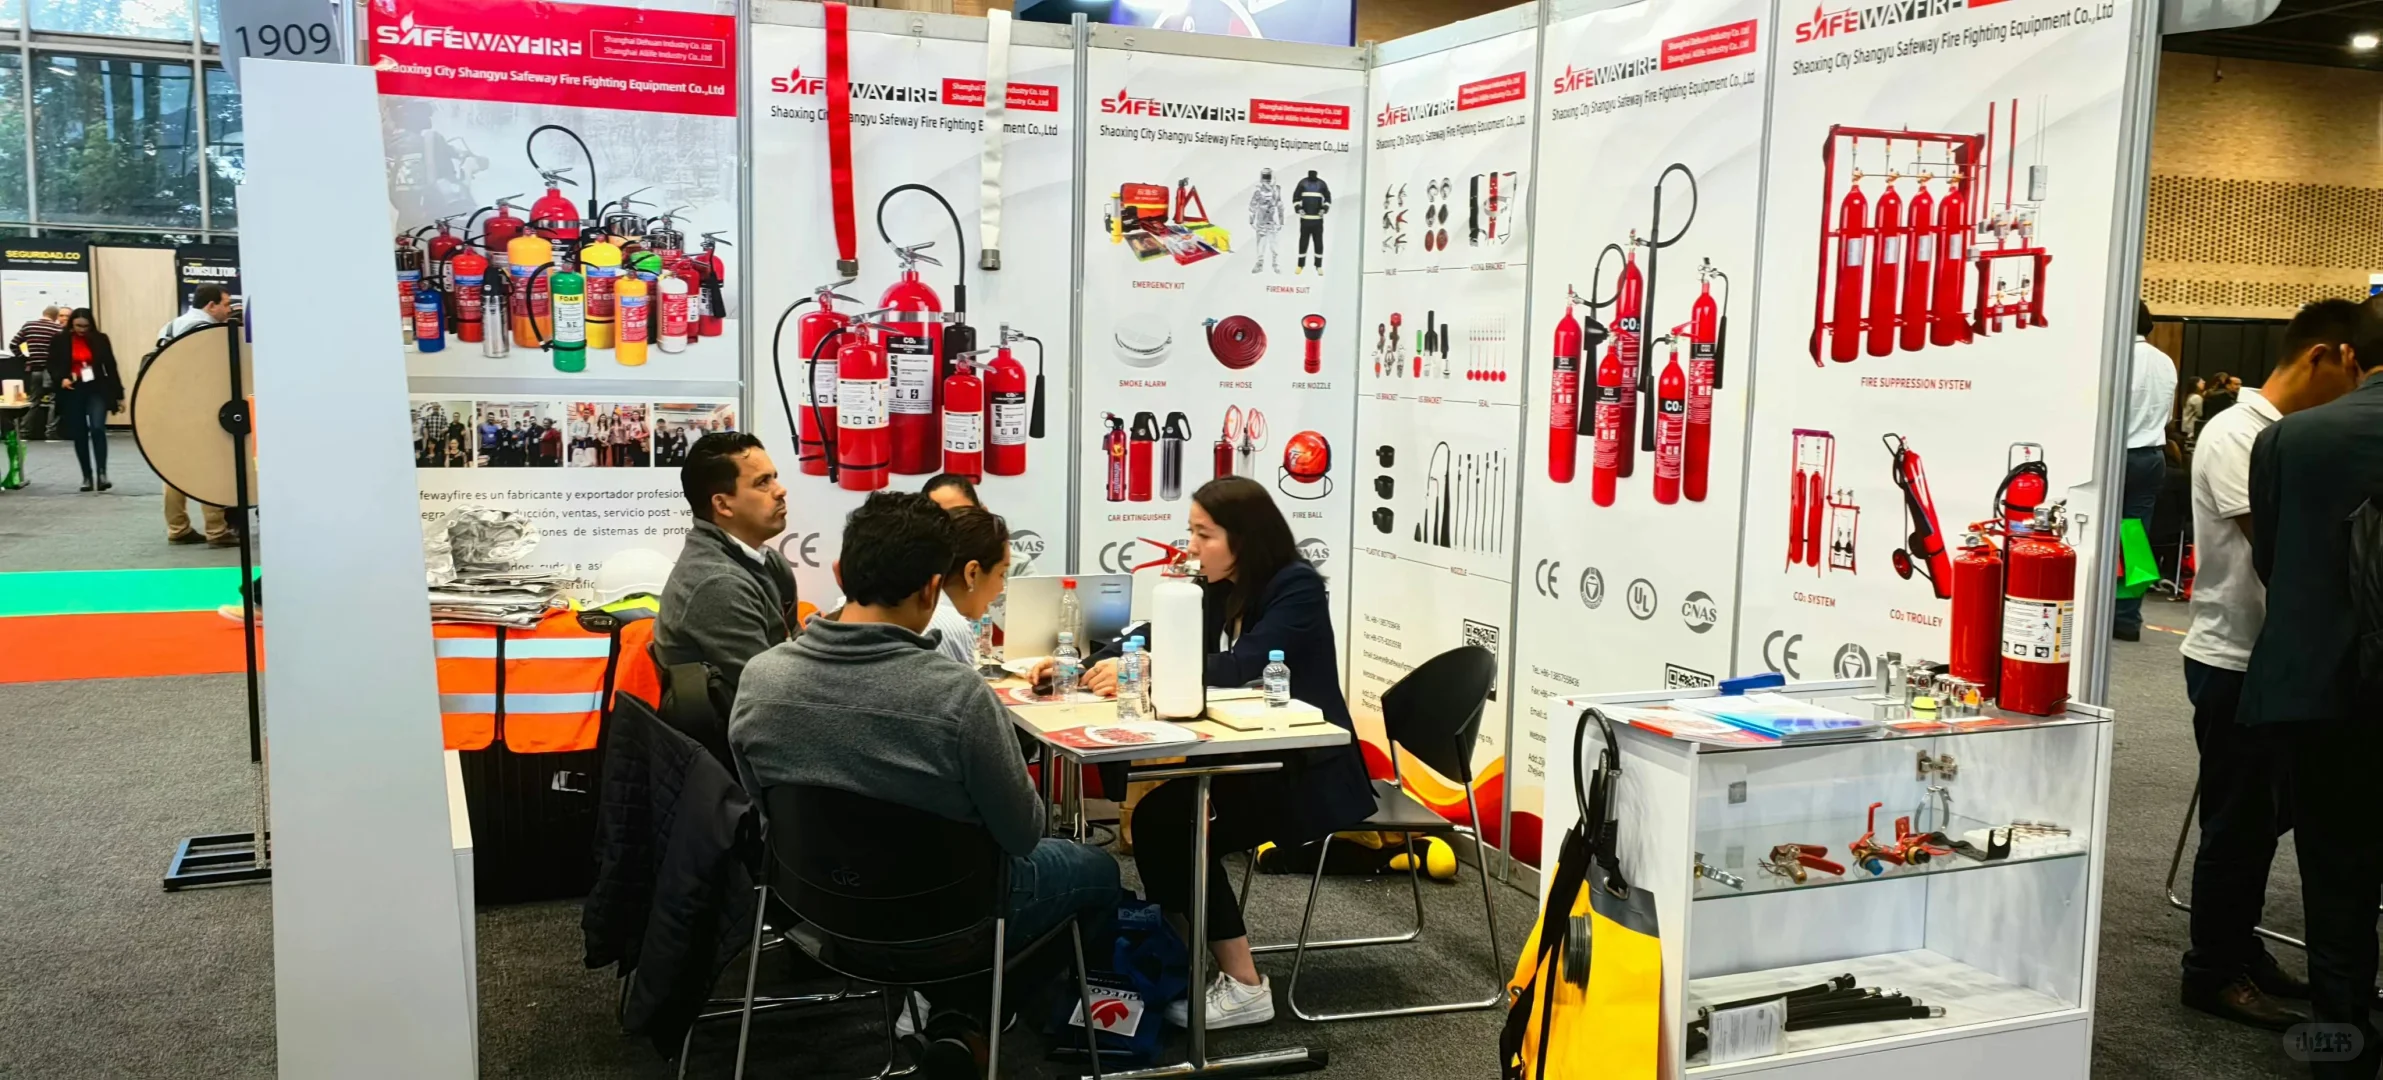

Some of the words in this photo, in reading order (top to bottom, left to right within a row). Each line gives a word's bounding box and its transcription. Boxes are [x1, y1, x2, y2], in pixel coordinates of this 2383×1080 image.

[235, 23, 331, 57] 1909
[377, 24, 582, 56] SAFEWAYFIRE
[603, 35, 635, 46] Shanghai
[1792, 54, 1834, 76] Shaoxing
[1835, 50, 1852, 70] City
[1854, 42, 1894, 66] Shangyu
[1896, 34, 1939, 58] Safeway
[1941, 29, 1960, 50] Fire
[1963, 20, 2007, 46] Fighting
[2010, 11, 2071, 40] Equipment
[434, 65, 456, 78] City
[458, 68, 508, 82] Shangyu
[510, 71, 558, 86] Safeway
[560, 74, 580, 85] Fire
[583, 76, 627, 91] Fighting
[629, 79, 686, 93] Equipment
[1554, 57, 1658, 94] SAFEWAYFIRE
[771, 76, 937, 103] SAFWAYFIRE
[1100, 97, 1246, 122] SAFEWAYFIRE
[771, 105, 815, 122] Shaoxing
[848, 113, 877, 126] angyu
[880, 113, 918, 130] Safeway
[921, 116, 937, 128] Fire
[940, 117, 976, 134] Fighting
[1100, 125, 1138, 140] Shaoxing
[1141, 127, 1155, 142] City
[1158, 128, 1192, 144] Shangyu
[1195, 132, 1229, 146] Safeway
[1231, 134, 1245, 146] Fire
[1248, 135, 1278, 150] Fighting
[1280, 138, 1321, 152] Equipment
[6, 250, 81, 260] SEGURIDAD.CO
[1132, 280, 1172, 290] EMERGENCY
[1174, 282, 1185, 290] KIT
[1266, 286, 1294, 294] FIREMAN
[1295, 286, 1310, 294] SUIT
[1119, 380, 1142, 388] SMOKE
[1144, 380, 1167, 388] ALARM
[1292, 382, 1306, 390] FIRE
[1308, 382, 1332, 390] NOZZLE
[1860, 376, 1878, 388] FIRE
[1880, 377, 1936, 389] SUPPRESSION
[1938, 379, 1972, 391] SYSTEM
[420, 490, 472, 502] fewayfire
[490, 492, 504, 500] un
[508, 490, 563, 500] fabricante
[566, 492, 572, 501] y
[575, 490, 634, 500] exportador
[562, 510, 601, 519] ventas,
[604, 508, 645, 517] servicio
[648, 508, 670, 518] post
[1108, 514, 1121, 522] CAR
[1122, 513, 1172, 522] EXTINGUISHER
[538, 528, 567, 536] iones
[574, 528, 586, 536] de
[592, 526, 638, 536] sistemas
[644, 526, 657, 535] de
[1300, 546, 1330, 560] NAS
[1634, 586, 1650, 613] UL
[1808, 594, 1836, 608] SYSTEM
[1682, 602, 1717, 623] CNAS
[1906, 611, 1943, 627] TROLLEY
